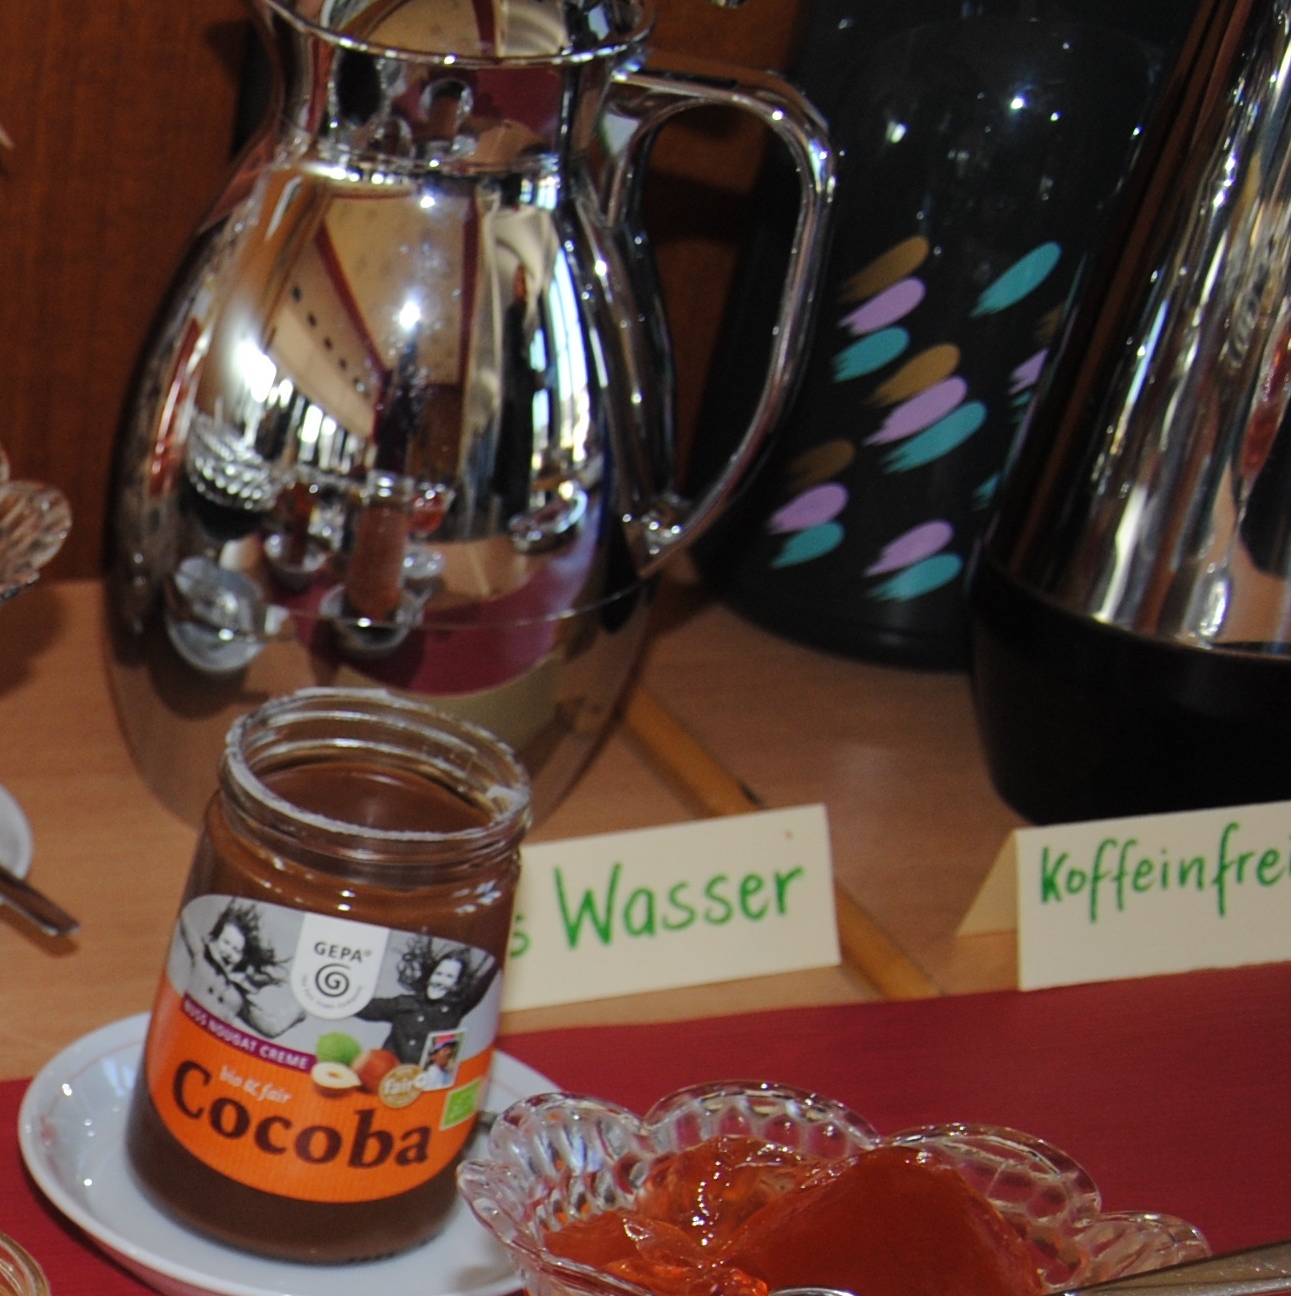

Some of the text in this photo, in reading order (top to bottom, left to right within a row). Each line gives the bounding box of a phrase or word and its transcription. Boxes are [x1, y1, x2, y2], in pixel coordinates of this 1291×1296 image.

[553, 862, 805, 951] Wasser
[313, 941, 364, 964] GEPA
[207, 1018, 258, 1053] NOUGAT
[258, 1045, 310, 1070] CREME
[171, 1058, 432, 1170] Cocoba
